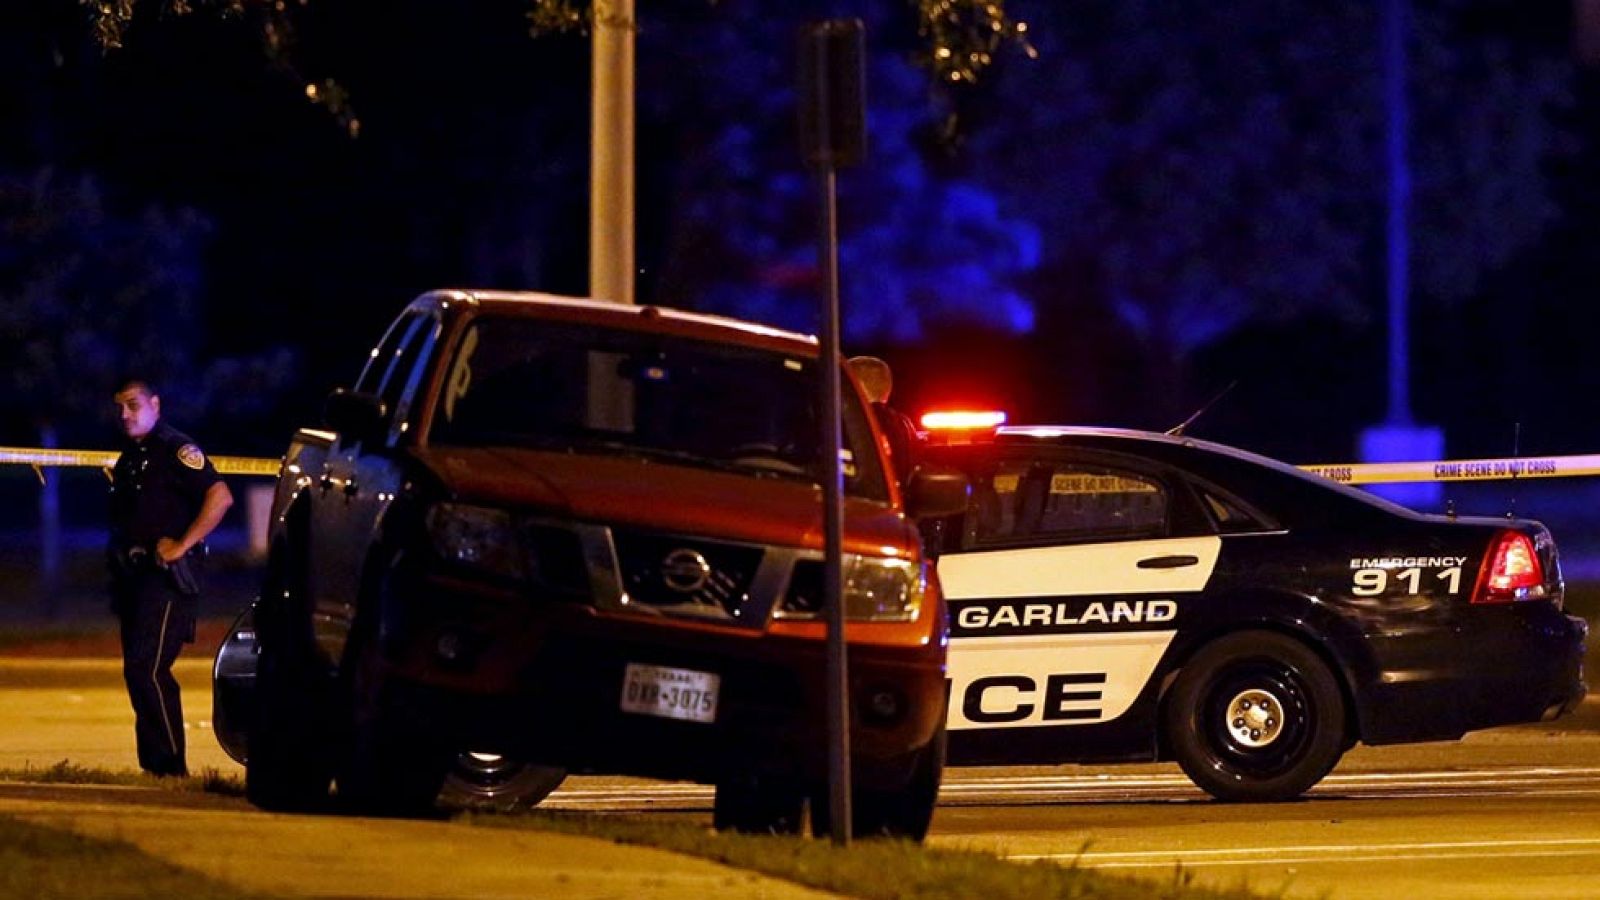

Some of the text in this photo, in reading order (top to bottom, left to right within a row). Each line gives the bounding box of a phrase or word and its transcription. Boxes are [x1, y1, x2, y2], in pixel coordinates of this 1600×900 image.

[1434, 460, 1556, 478] CRIME SCENE DO NOT CROSS
[1351, 556, 1468, 569] EMERGENCY
[1351, 568, 1462, 596] 911
[957, 600, 1178, 629] GARLAND
